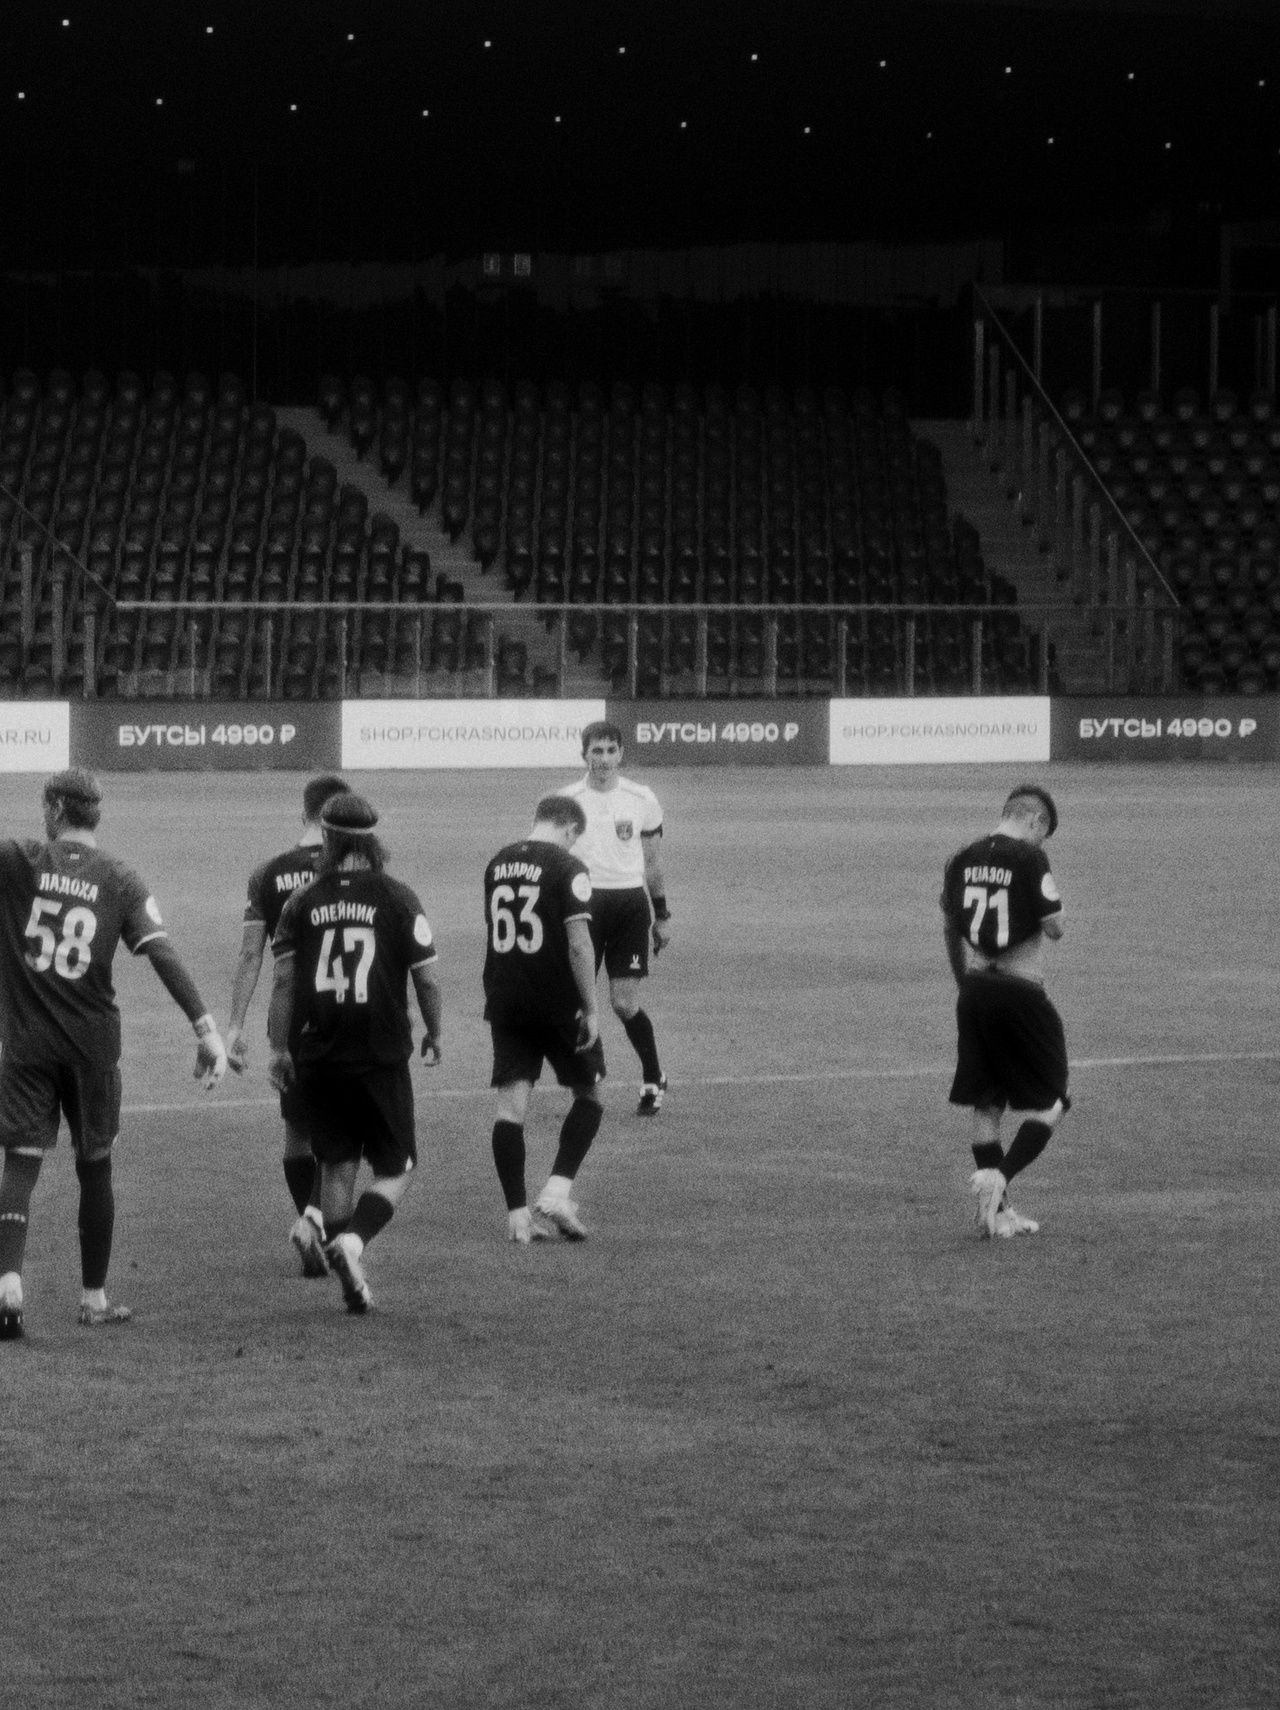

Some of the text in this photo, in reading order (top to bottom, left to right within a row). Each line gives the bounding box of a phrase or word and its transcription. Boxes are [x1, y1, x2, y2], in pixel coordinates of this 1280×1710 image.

[118, 724, 207, 747] БУТСЫ
[212, 724, 275, 746] 4990
[635, 722, 717, 744] БУТСЫ
[720, 722, 780, 743] 4990
[842, 723, 1038, 738] SHOP.FCKRASNODAR.RU
[1079, 718, 1162, 740] БУТСЫ
[1166, 717, 1232, 739] 4990
[493, 861, 543, 883] ЗАХАРОВ
[38, 872, 99, 903] ЛАДОХА
[310, 900, 378, 927] ОЛЕЙНИК
[490, 885, 544, 955] 63
[963, 886, 1010, 949] 71
[24, 896, 98, 980] 58
[314, 928, 376, 1005] 47
